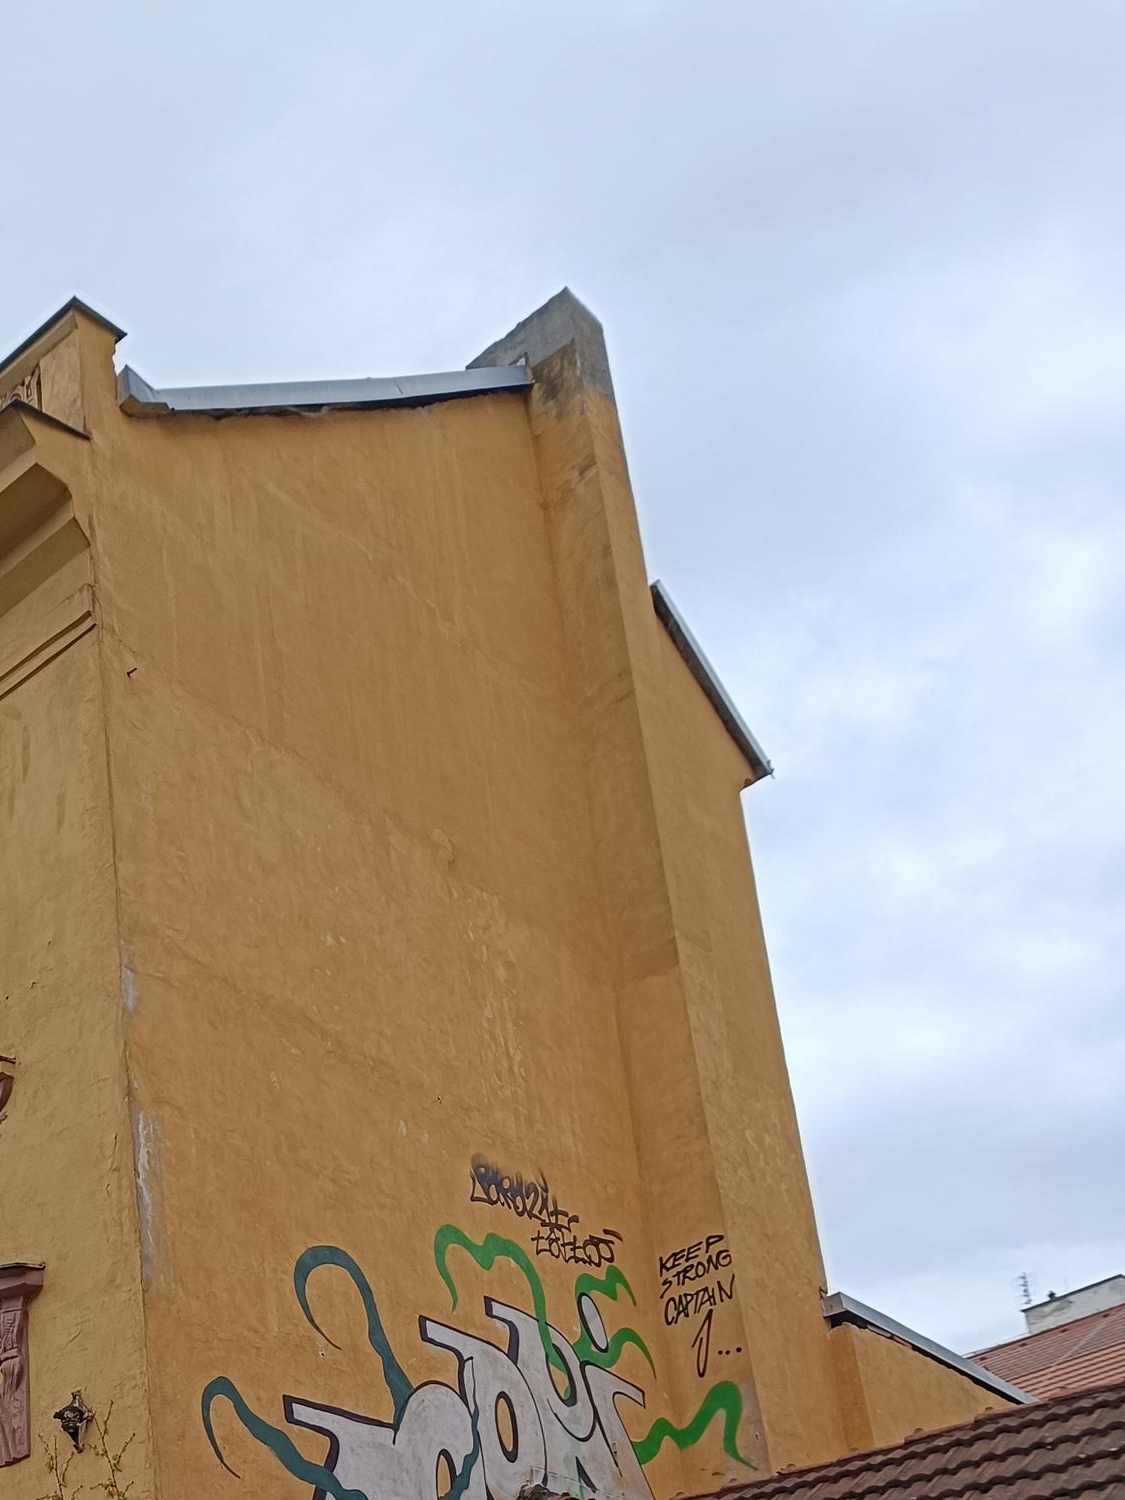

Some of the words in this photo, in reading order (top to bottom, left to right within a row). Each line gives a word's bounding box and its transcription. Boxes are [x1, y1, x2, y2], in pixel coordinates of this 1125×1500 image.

[659, 1234, 724, 1277] KEEP
[660, 1249, 732, 1299] STRONG
[664, 1273, 735, 1326] CAPTAIN
